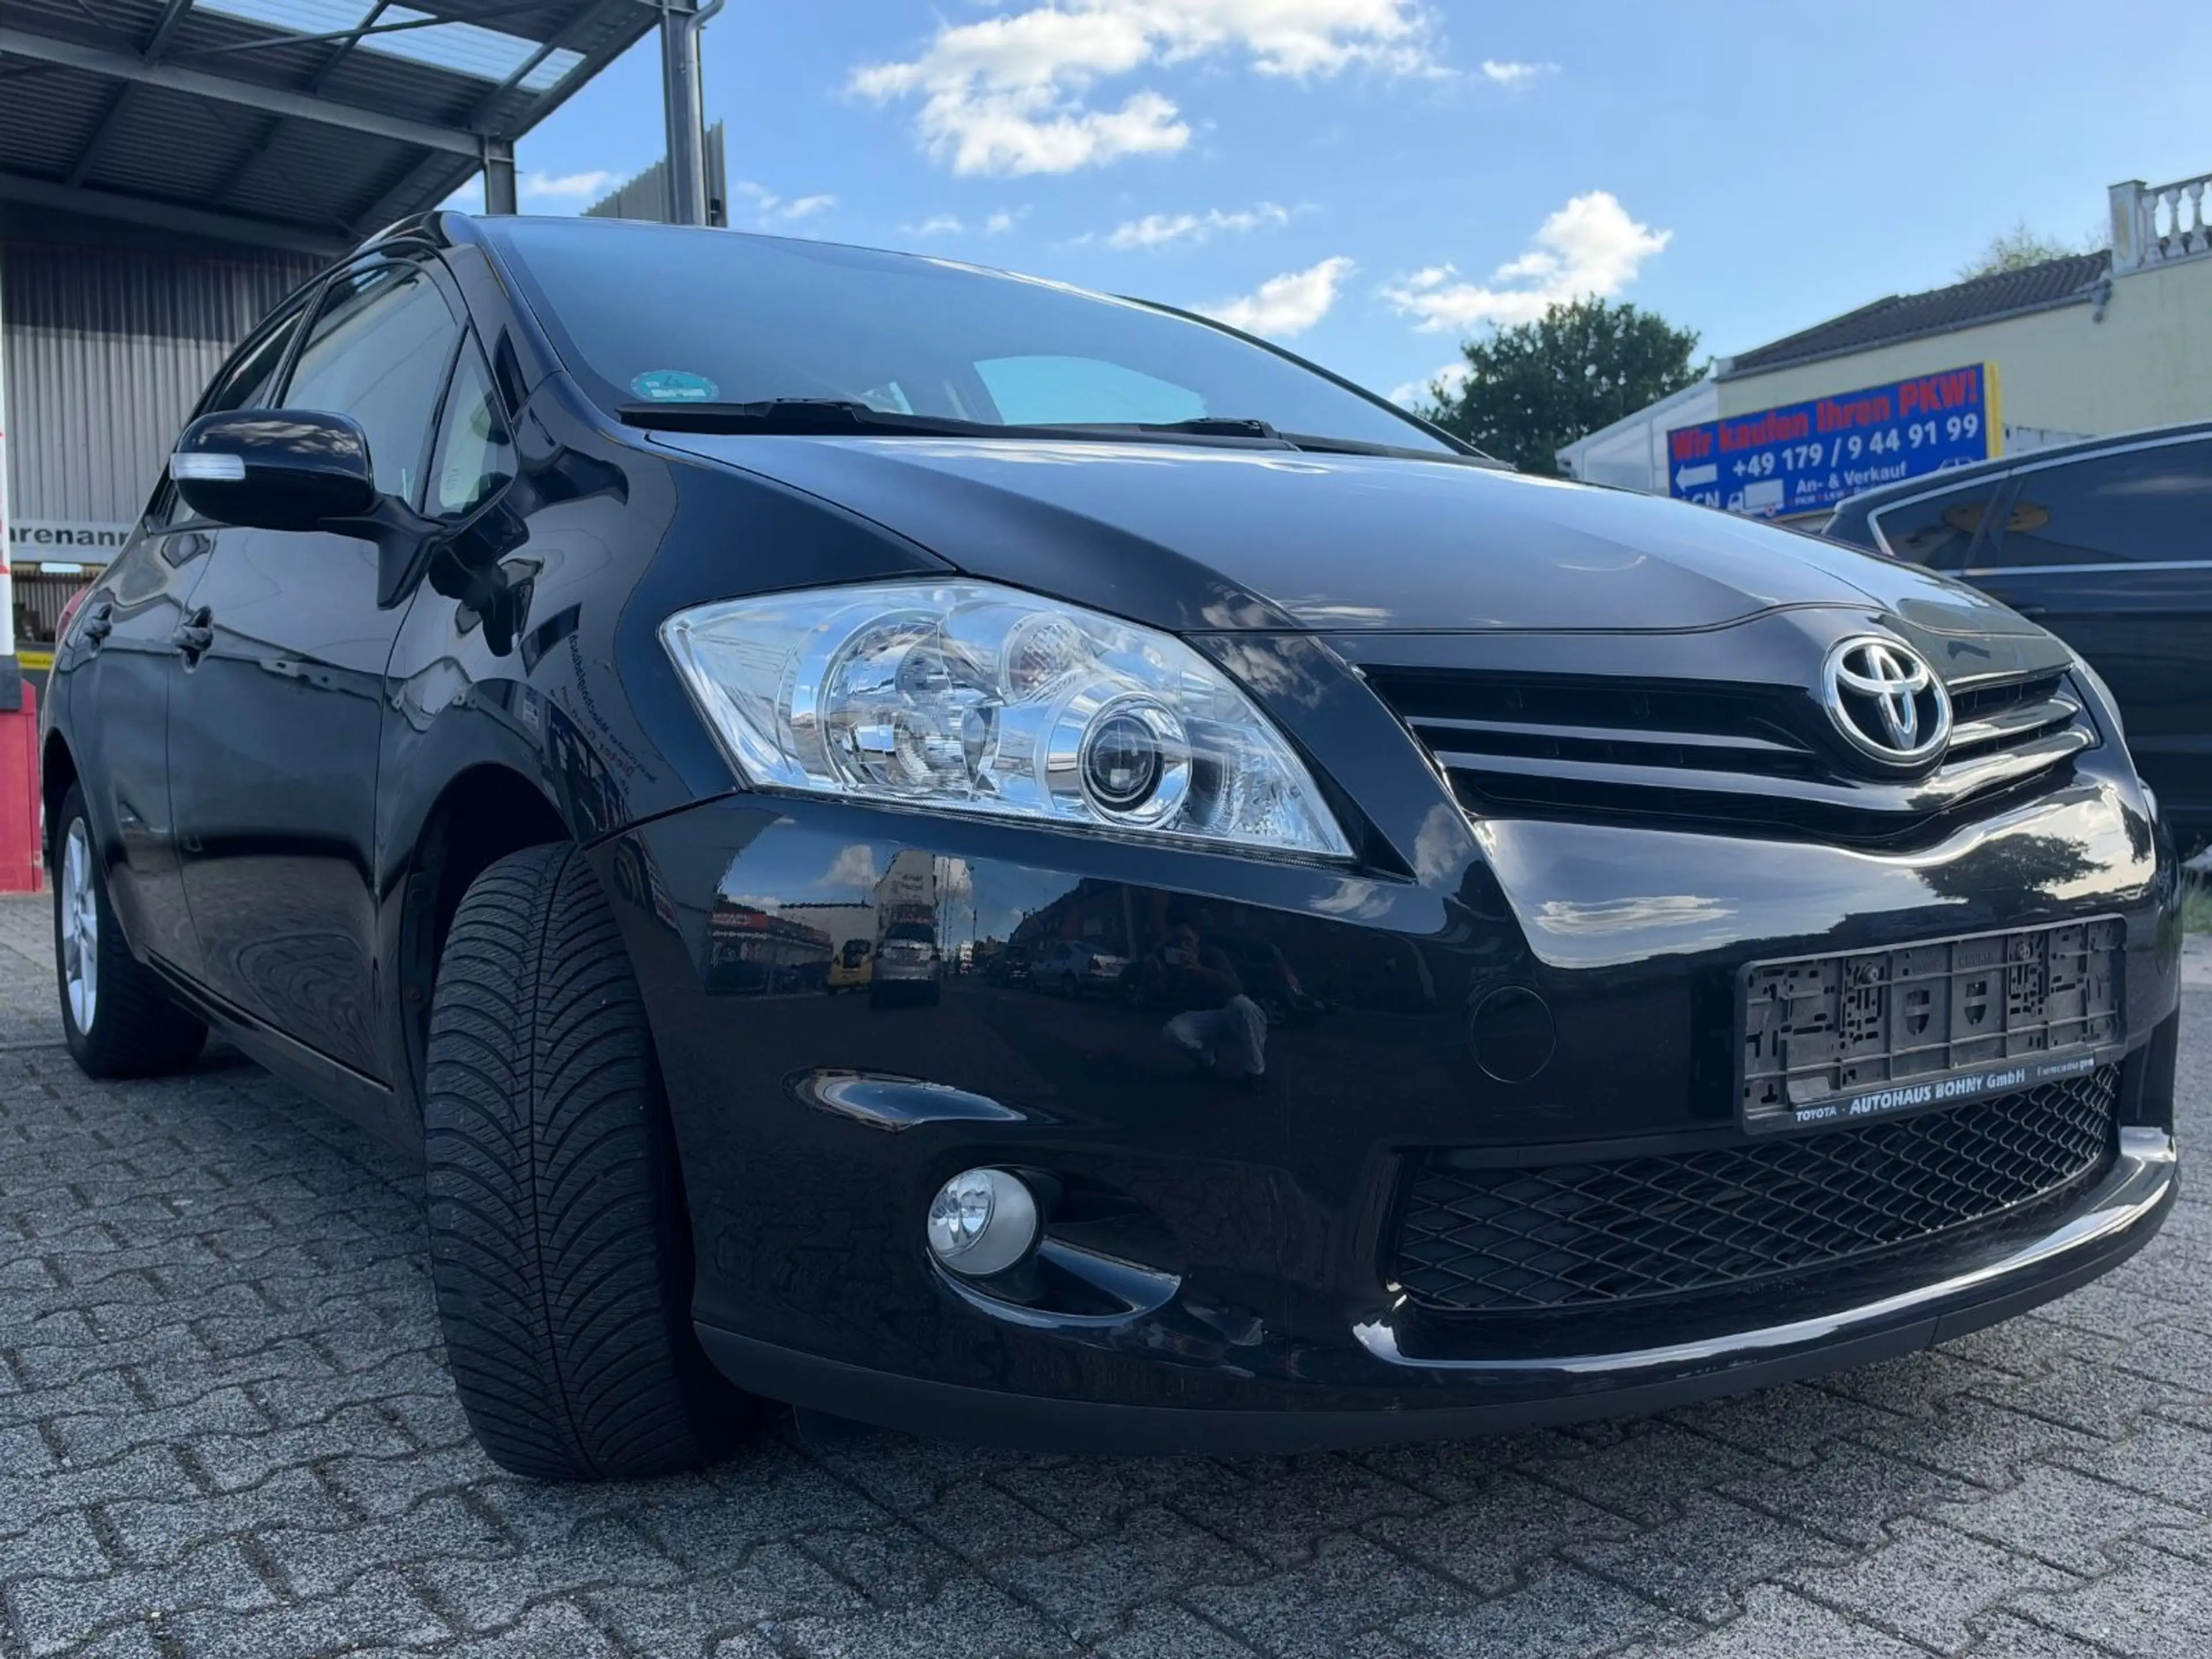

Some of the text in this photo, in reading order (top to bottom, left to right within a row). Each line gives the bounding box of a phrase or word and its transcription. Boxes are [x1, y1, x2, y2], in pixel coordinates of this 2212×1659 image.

[1673, 370, 1978, 460] Wir kaufen Ihren PKW!
[1733, 453, 1775, 478] +49
[1782, 442, 1823, 471] 179
[1847, 435, 1863, 460] 9
[1869, 427, 1900, 454] 44
[1908, 421, 1937, 449] 91
[1946, 413, 1978, 442] 99
[1796, 478, 1824, 495] An-
[1828, 473, 1840, 489] &
[1844, 460, 1907, 486] Verkauf
[1796, 1106, 1837, 1122] TOYOTA
[1850, 1085, 1931, 1115] AUTOHAUS
[1987, 1068, 2025, 1089] GmbH
